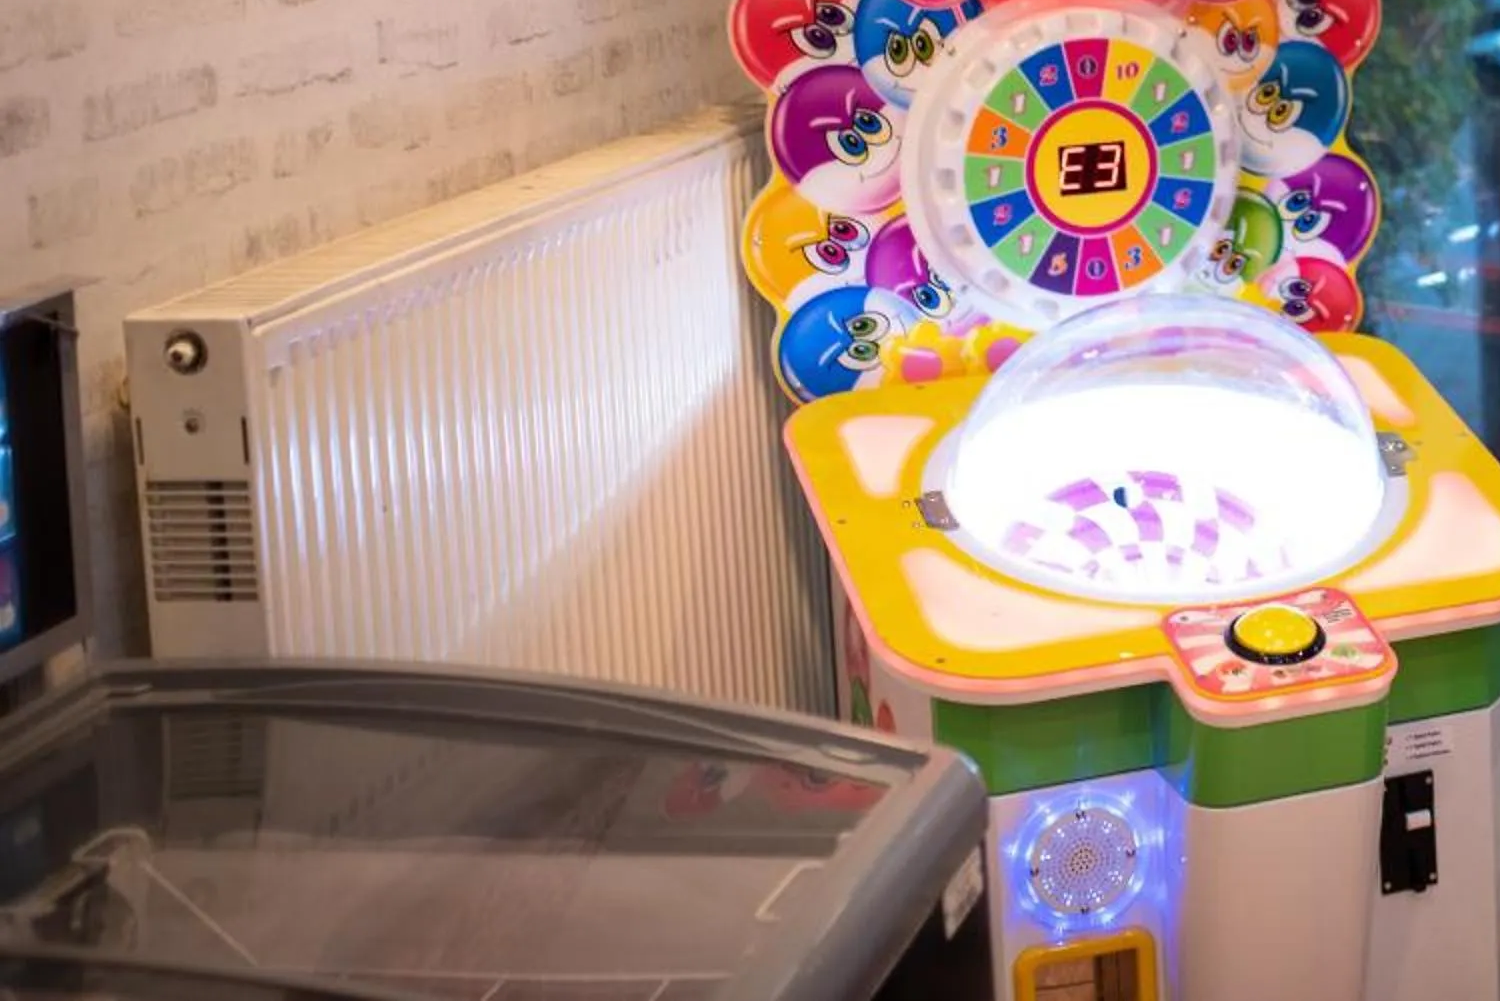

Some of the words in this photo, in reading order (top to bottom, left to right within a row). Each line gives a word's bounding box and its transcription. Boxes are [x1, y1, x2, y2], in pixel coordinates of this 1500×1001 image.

[1116, 62, 1139, 81] 10
[1154, 81, 1168, 102] 1
[1011, 93, 1026, 114] 1
[991, 126, 1009, 150] 3
[1180, 150, 1195, 171] 1
[987, 166, 1003, 189] 1
[1018, 231, 1036, 256] 1
[1157, 226, 1173, 248] 1
[1124, 246, 1143, 270] 3
